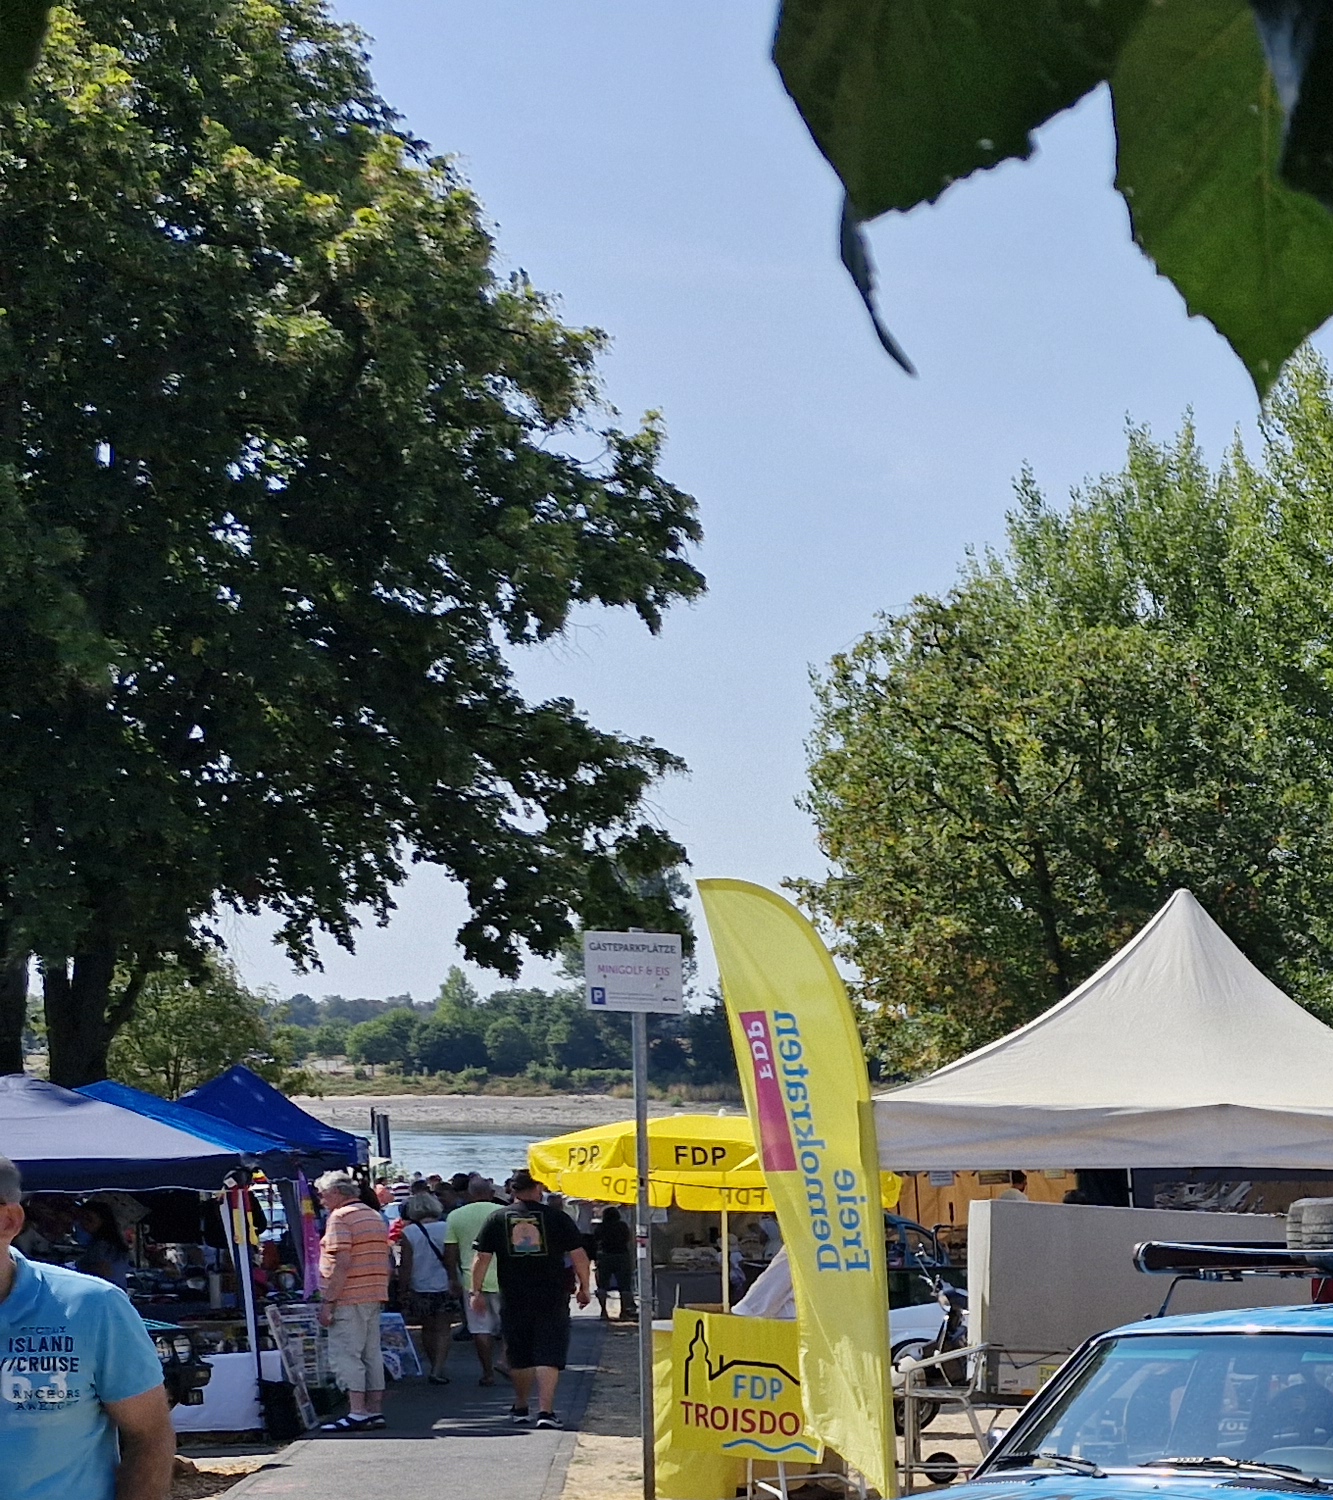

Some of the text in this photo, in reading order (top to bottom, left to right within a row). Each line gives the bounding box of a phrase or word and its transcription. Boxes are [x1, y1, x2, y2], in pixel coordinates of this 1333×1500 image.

[597, 965, 670, 976] MINIGOLF & EIS
[568, 1145, 600, 1167] FDP
[675, 1145, 726, 1166] FDP
[9, 1336, 74, 1353] ISLAND
[733, 1374, 784, 1401] FDP
[680, 1401, 800, 1436] TROISDO
